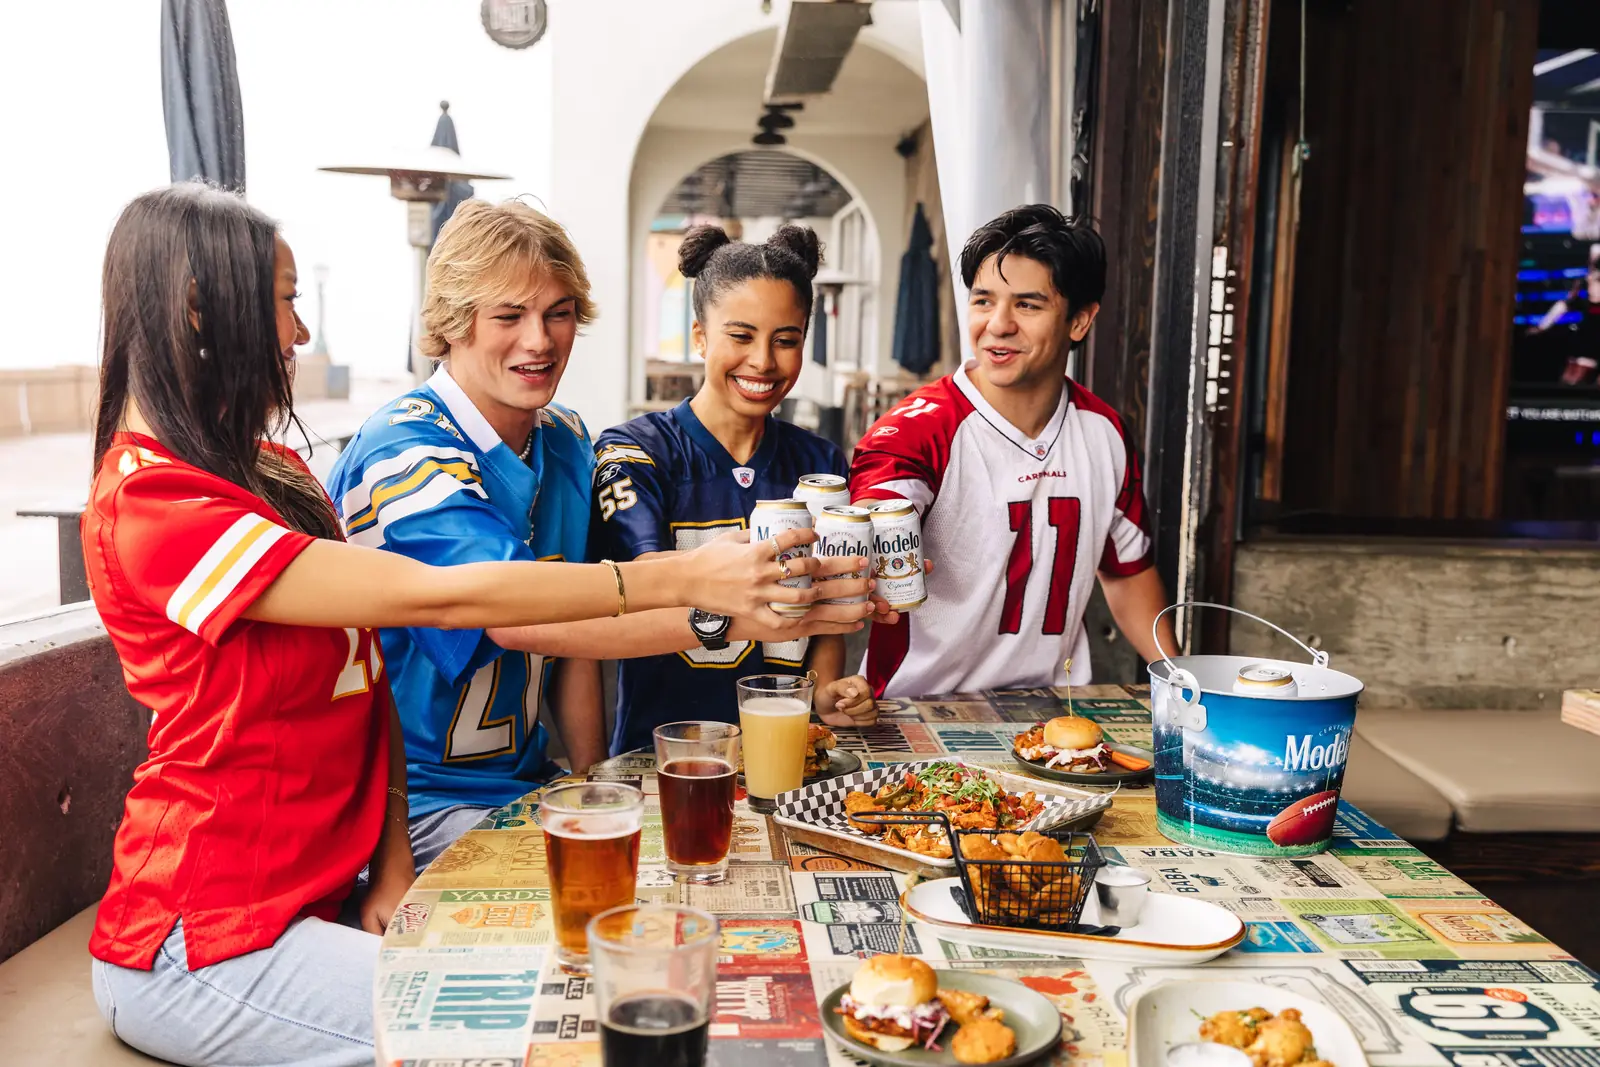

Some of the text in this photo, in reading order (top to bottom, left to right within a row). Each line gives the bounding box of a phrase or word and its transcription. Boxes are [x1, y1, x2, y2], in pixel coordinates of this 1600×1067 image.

[598, 477, 638, 523] 55
[816, 536, 868, 556] Modelo
[872, 531, 920, 554] Modelo
[997, 496, 1081, 635] 11
[1282, 728, 1351, 772] Model
[1159, 867, 1201, 894] BABA
[449, 889, 551, 901] YARDS
[396, 970, 429, 1020] SEATTLE
[428, 969, 541, 1030] TRIP
[567, 978, 584, 999] ALE
[560, 1015, 578, 1039] ALE
